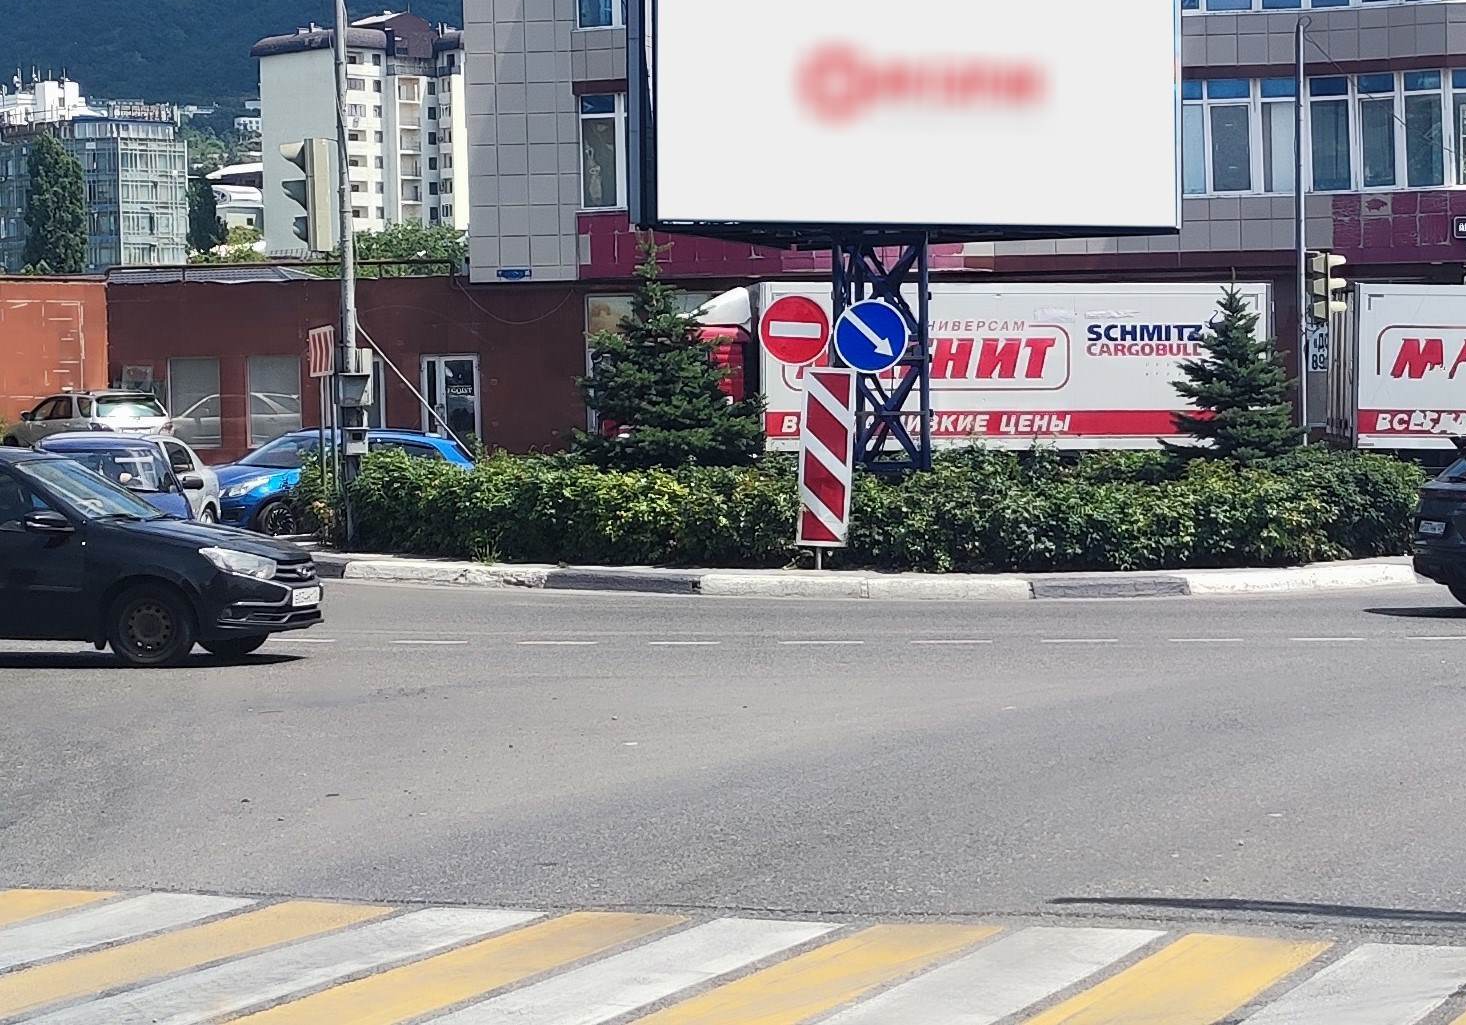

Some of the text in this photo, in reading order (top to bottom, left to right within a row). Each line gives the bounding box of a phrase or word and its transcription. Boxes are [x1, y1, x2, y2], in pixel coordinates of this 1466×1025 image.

[926, 320, 1025, 332] НИВЕРСАМ
[1087, 324, 1202, 342] SCHMITZ
[1000, 414, 1071, 434] ЦЕНЫ
